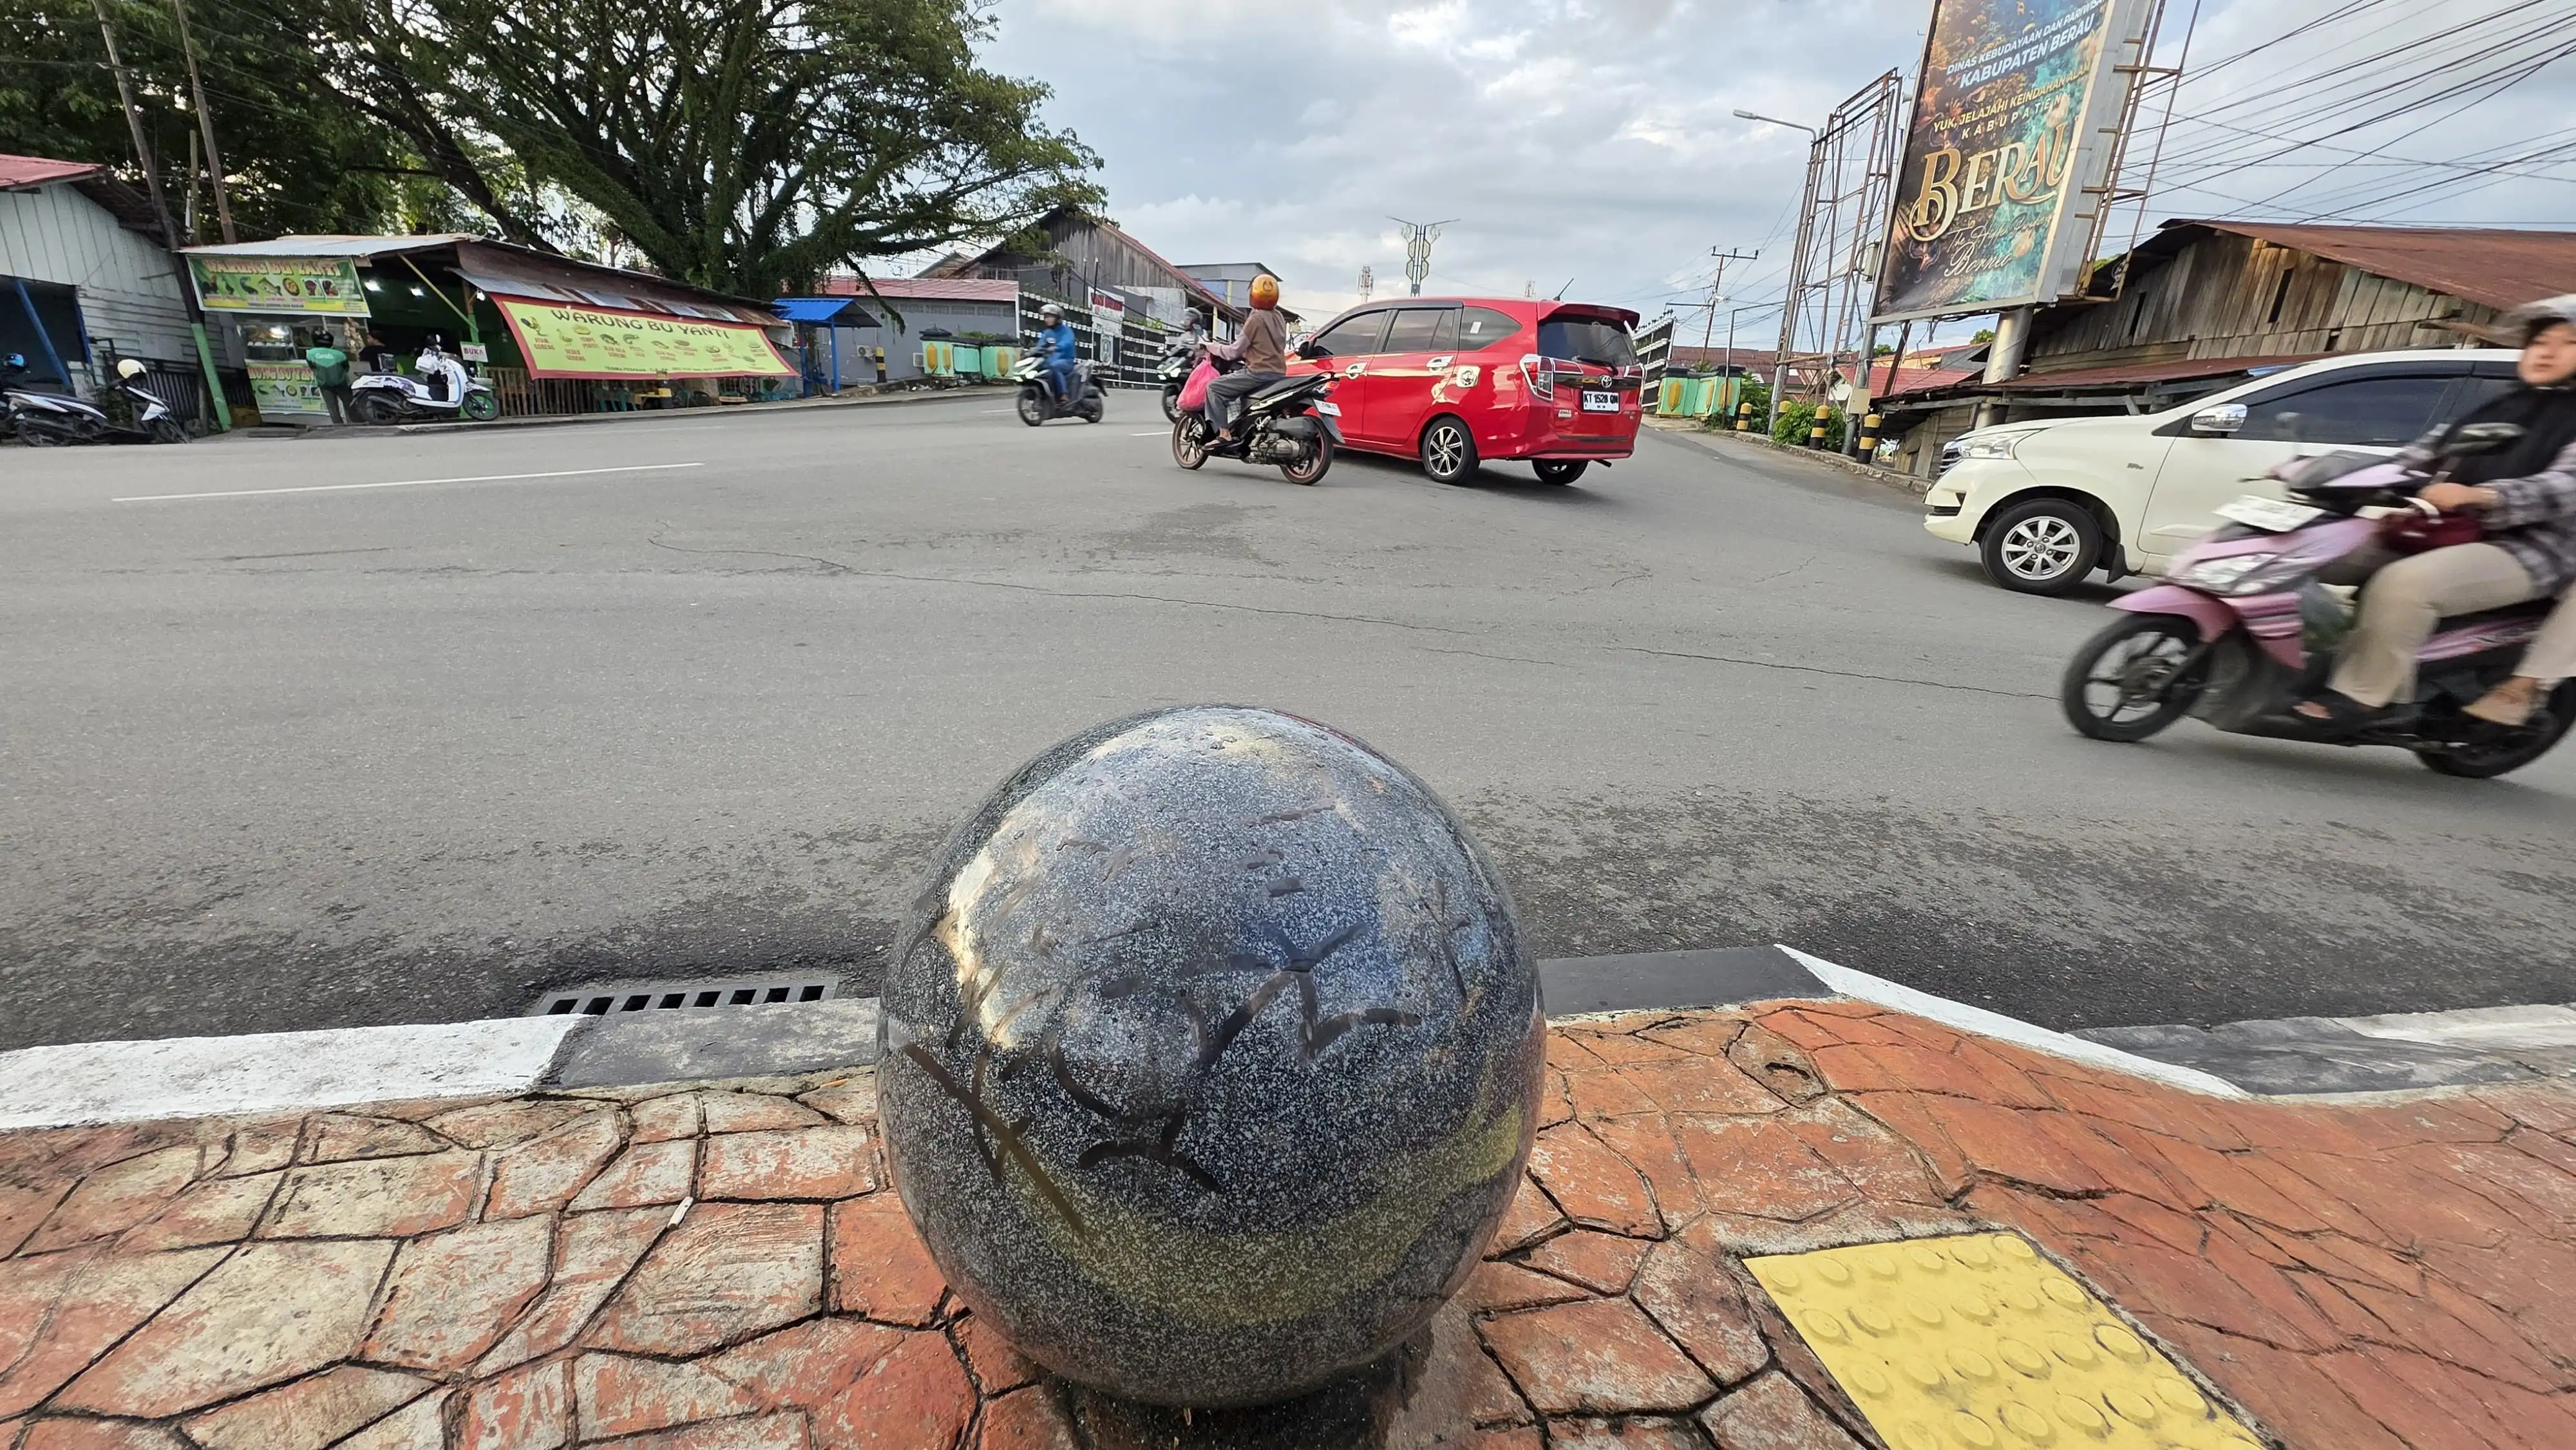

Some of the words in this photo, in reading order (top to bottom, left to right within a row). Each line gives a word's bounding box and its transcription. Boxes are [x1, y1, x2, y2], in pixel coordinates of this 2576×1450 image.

[1947, 56, 1977, 75] DINAS
[1978, 27, 2043, 64] KEBUDAYAAN
[2043, 21, 2063, 37] DAN
[2063, 0, 2103, 26] PARIWIS
[1960, 41, 2049, 88] KABUPATEN
[2049, 13, 2095, 52] BERAU
[1934, 118, 1957, 133] YUK,
[1958, 100, 2007, 125] JELAJAHI
[2010, 75, 2065, 108] KEINDAHAN
[1961, 93, 2063, 140] KABUPATEN
[1909, 120, 2074, 241] BERAU
[1947, 220, 1975, 252] The
[1944, 241, 2012, 277] Borneo
[551, 309, 643, 330] WARUNG
[646, 320, 673, 333] BU
[677, 325, 730, 339] YANTI
[463, 348, 484, 356] BUKA
[1584, 393, 1593, 404] KT
